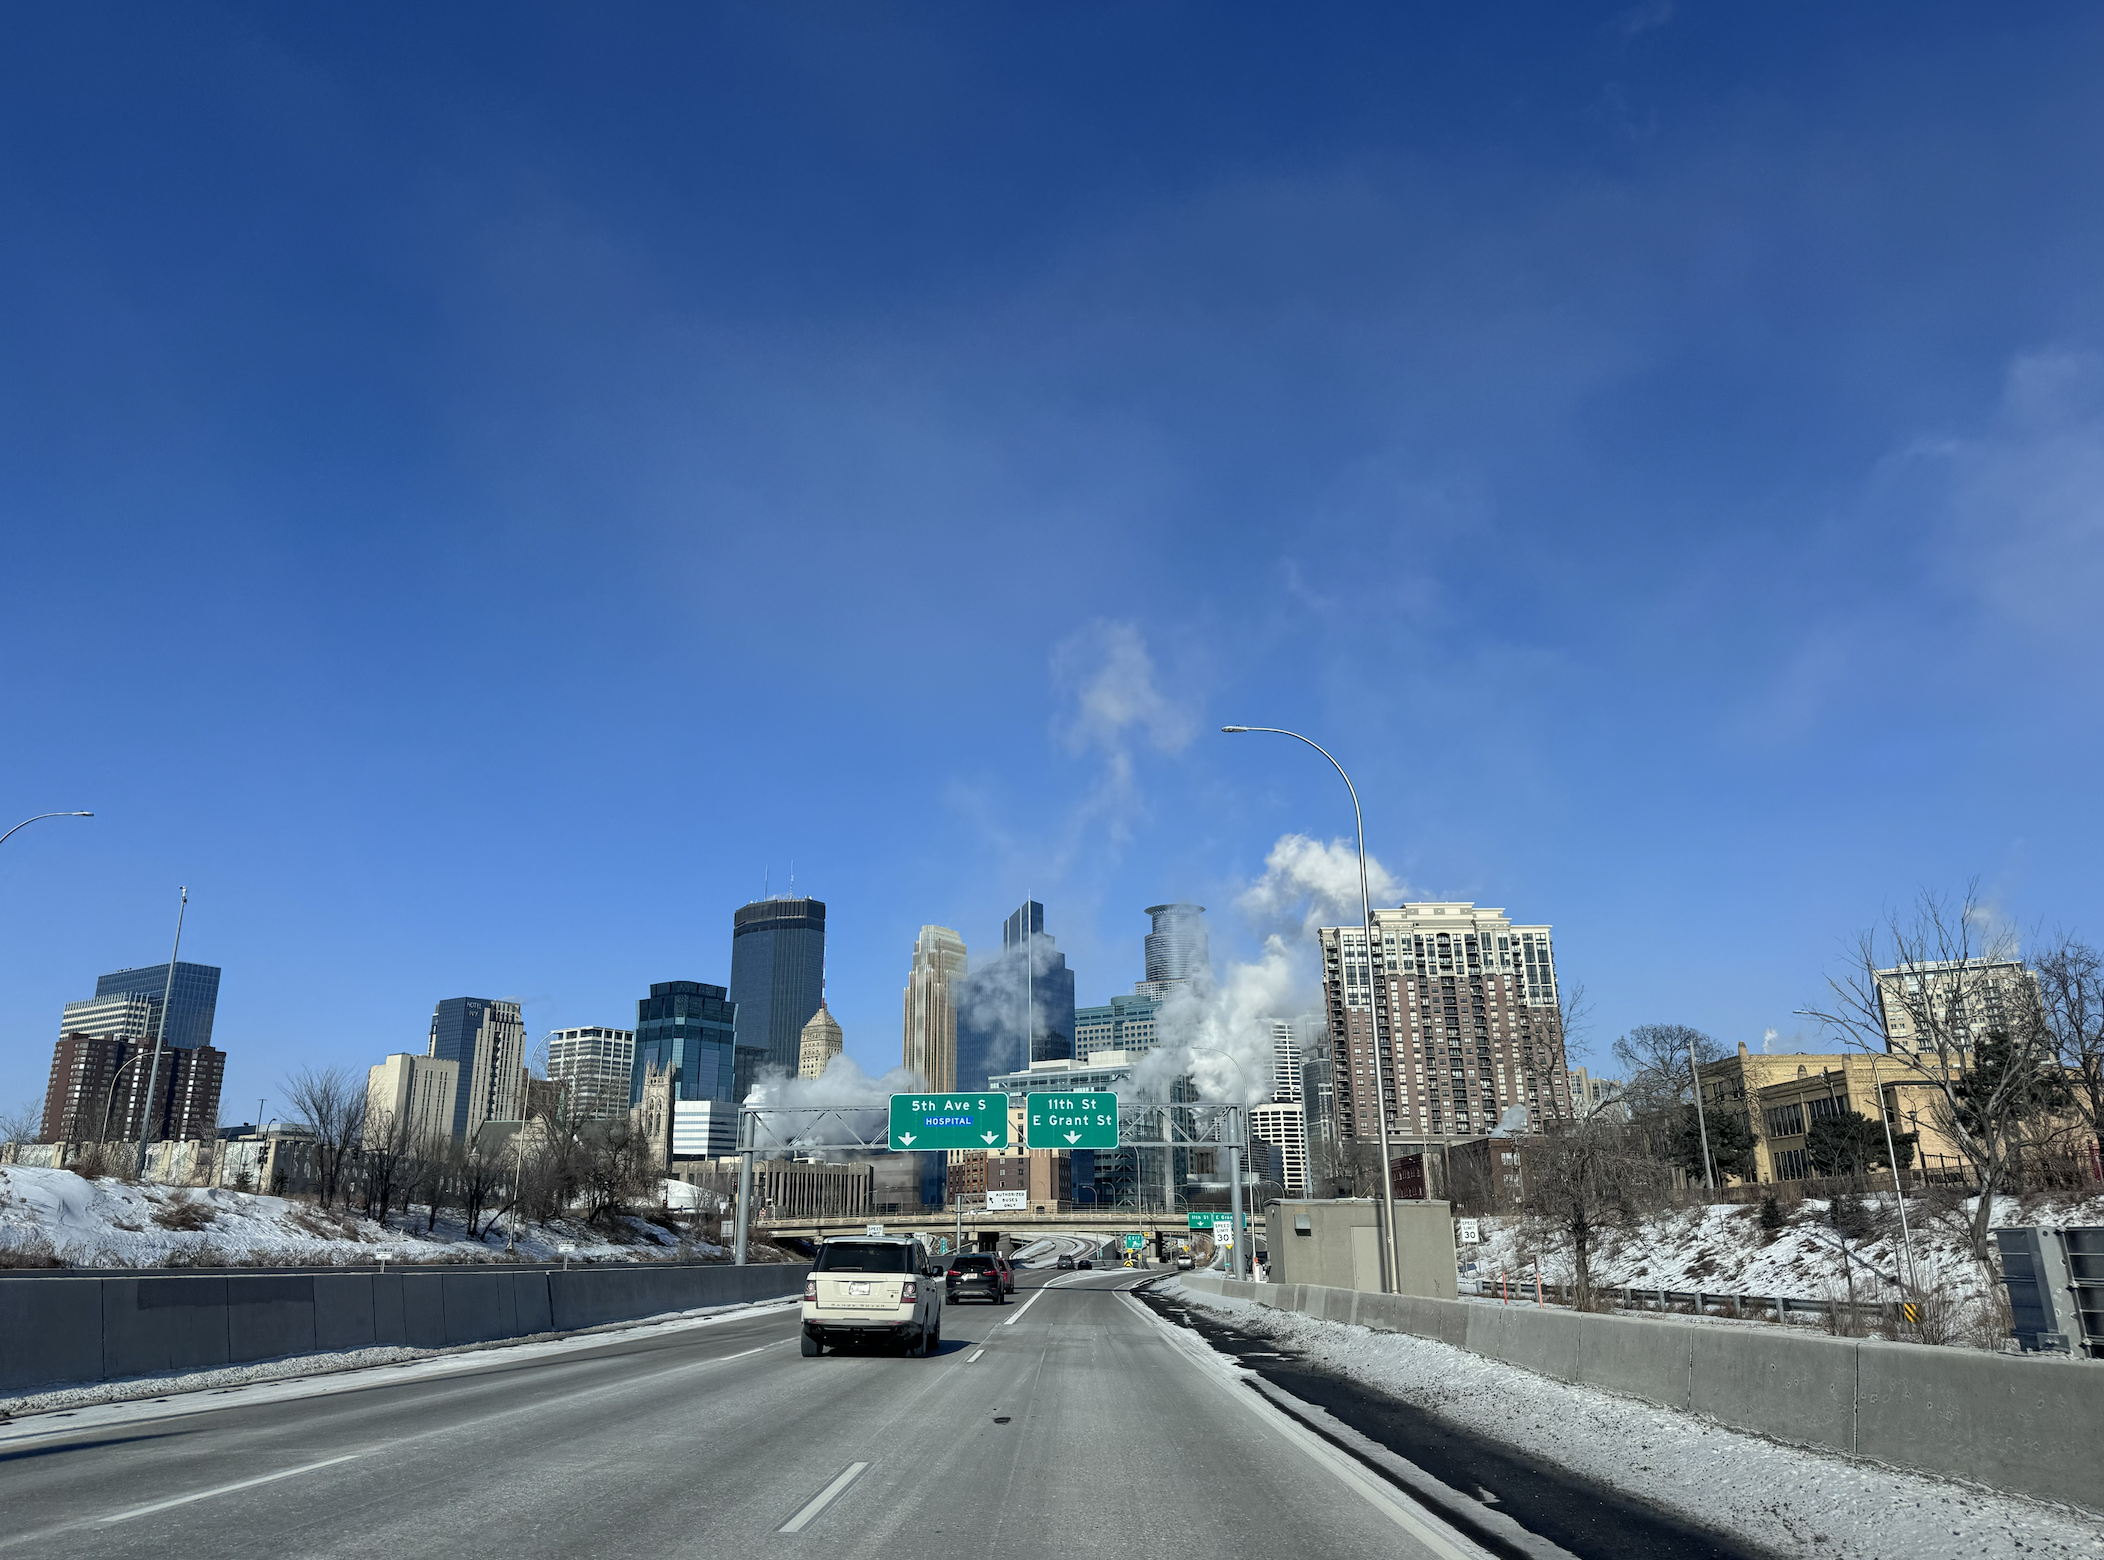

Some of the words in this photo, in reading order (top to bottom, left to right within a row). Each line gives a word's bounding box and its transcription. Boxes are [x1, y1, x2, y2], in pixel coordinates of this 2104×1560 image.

[912, 1101, 936, 1111] 5th
[944, 1100, 970, 1111] Ave
[978, 1099, 986, 1110] S
[1048, 1098, 1074, 1110] 11th
[1082, 1098, 1097, 1110] St
[925, 1116, 971, 1126] HOSPITAL
[1032, 1115, 1041, 1126] E
[1049, 1115, 1089, 1126] Grant
[1097, 1115, 1112, 1126] St
